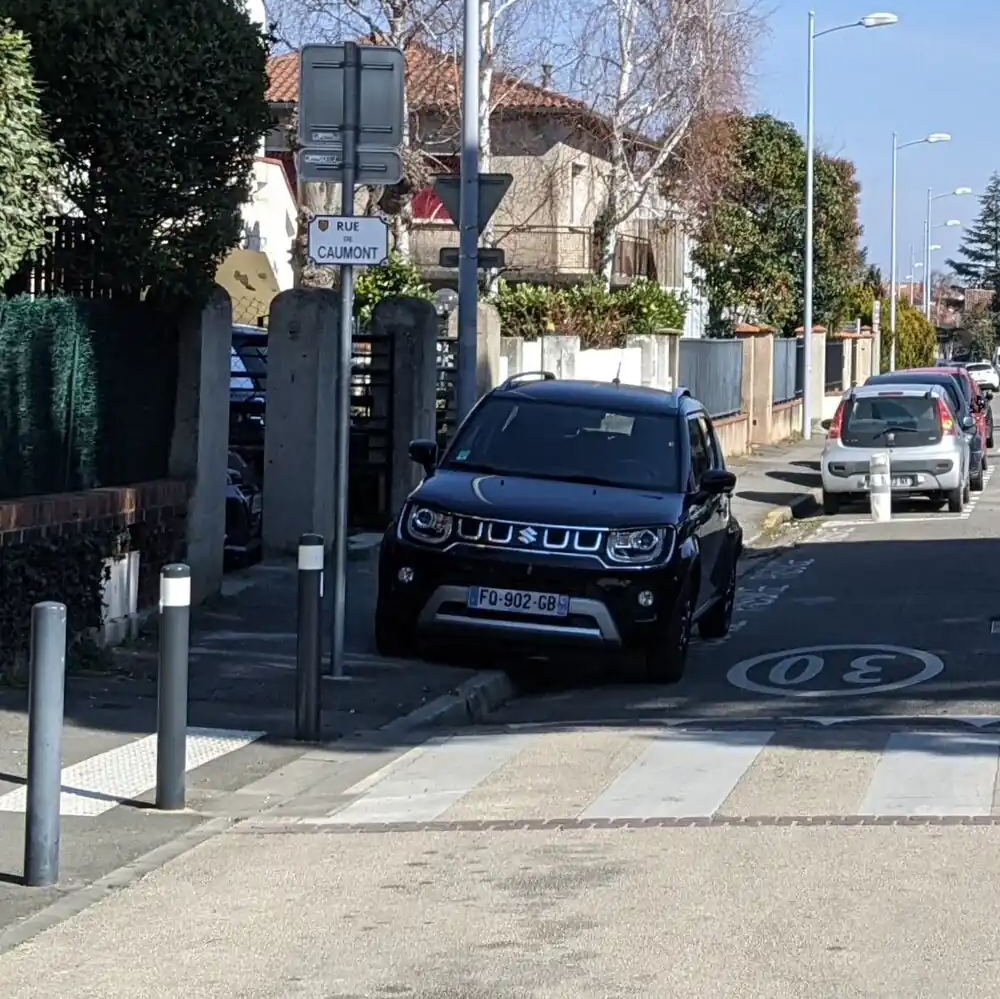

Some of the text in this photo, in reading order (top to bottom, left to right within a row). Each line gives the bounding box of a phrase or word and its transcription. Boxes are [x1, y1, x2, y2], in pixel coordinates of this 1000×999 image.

[336, 221, 360, 232] RUE
[317, 245, 378, 260] CAUMONT
[768, 654, 897, 685] 30
